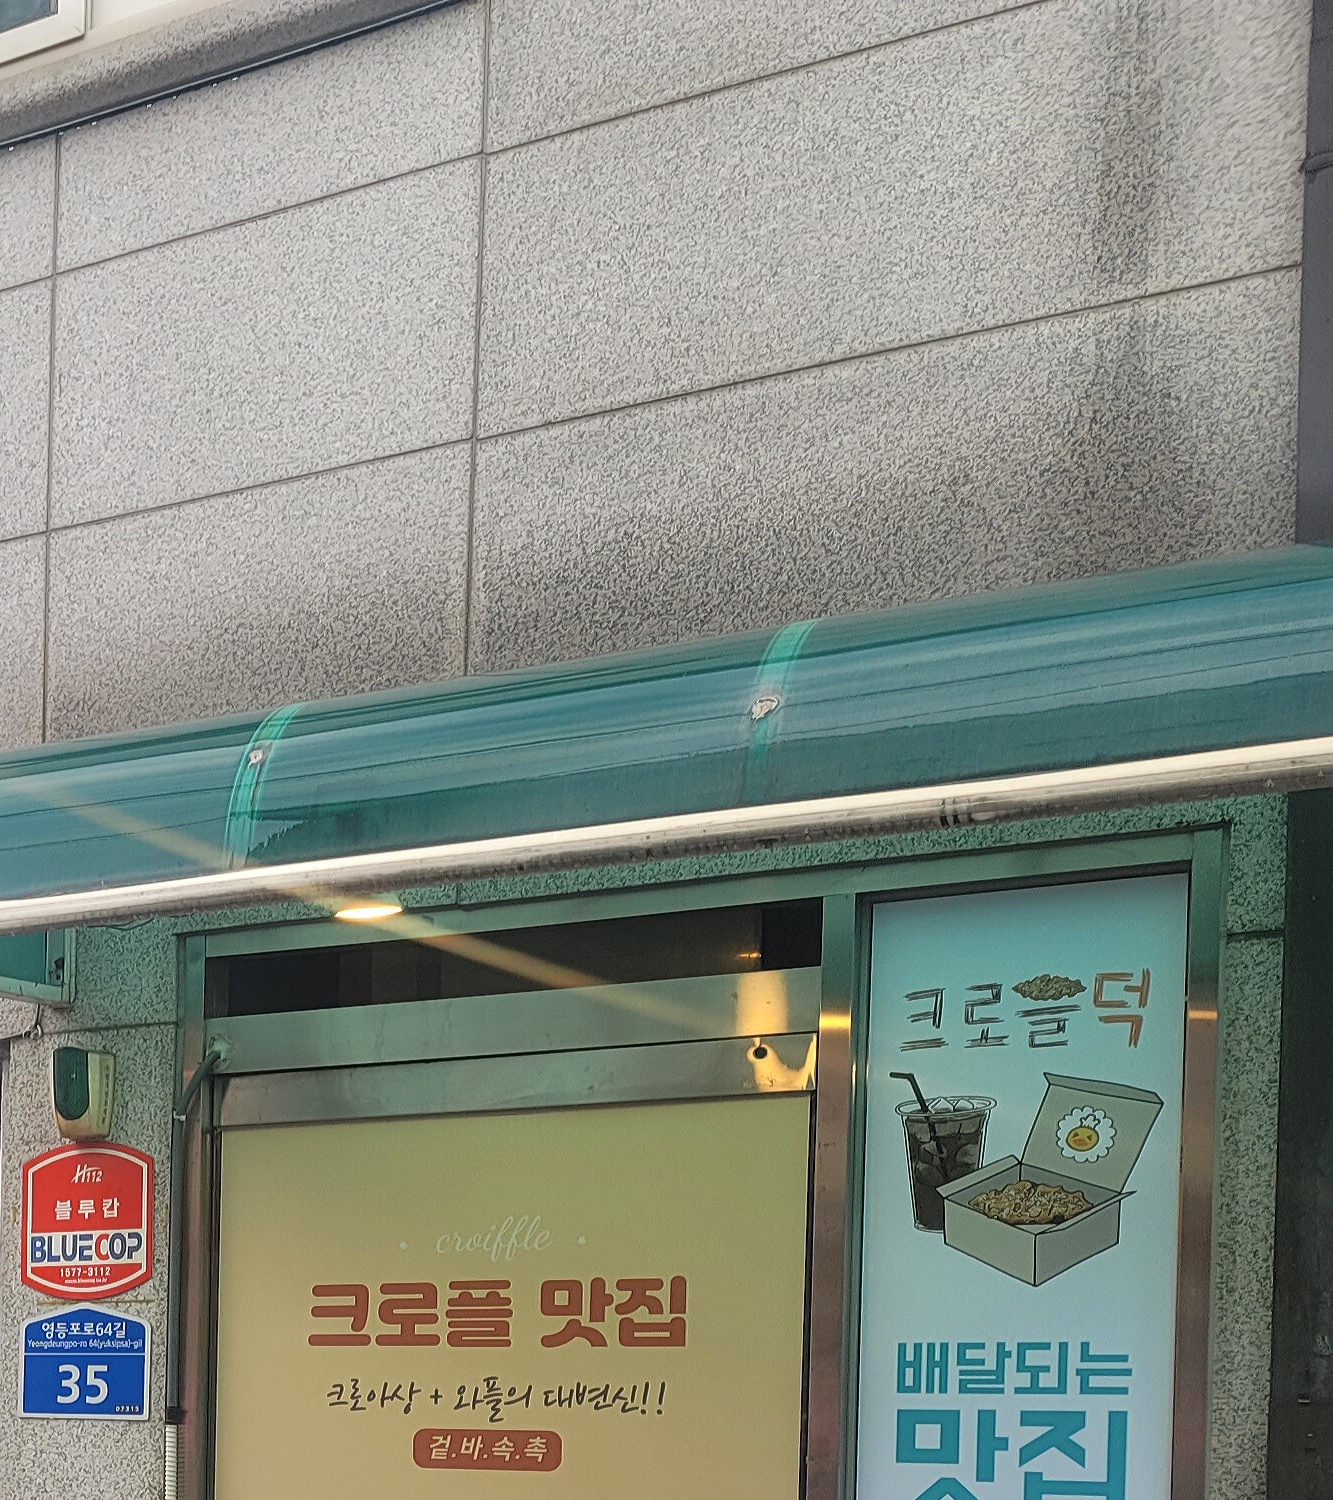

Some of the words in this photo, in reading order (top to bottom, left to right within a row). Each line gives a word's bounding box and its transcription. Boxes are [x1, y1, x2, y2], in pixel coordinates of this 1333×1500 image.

[54, 1197, 120, 1221] 블루캅
[30, 1231, 144, 1263] BLUECOP
[436, 1215, 555, 1262] croiffle
[60, 1266, 111, 1278] 1577-3112
[307, 1279, 514, 1349] 크로플
[540, 1275, 687, 1349] 맛집
[28, 1339, 87, 1350] Yeongdeungpo-ro
[41, 1321, 126, 1340] 영등포로64길
[895, 1340, 1134, 1396] 배달되는
[56, 1364, 109, 1405] 35
[326, 1378, 422, 1416] 크로아상
[452, 1376, 533, 1423] 와플의
[542, 1380, 667, 1416] 대변신!!
[428, 1433, 549, 1463] 겉.바.속.촉
